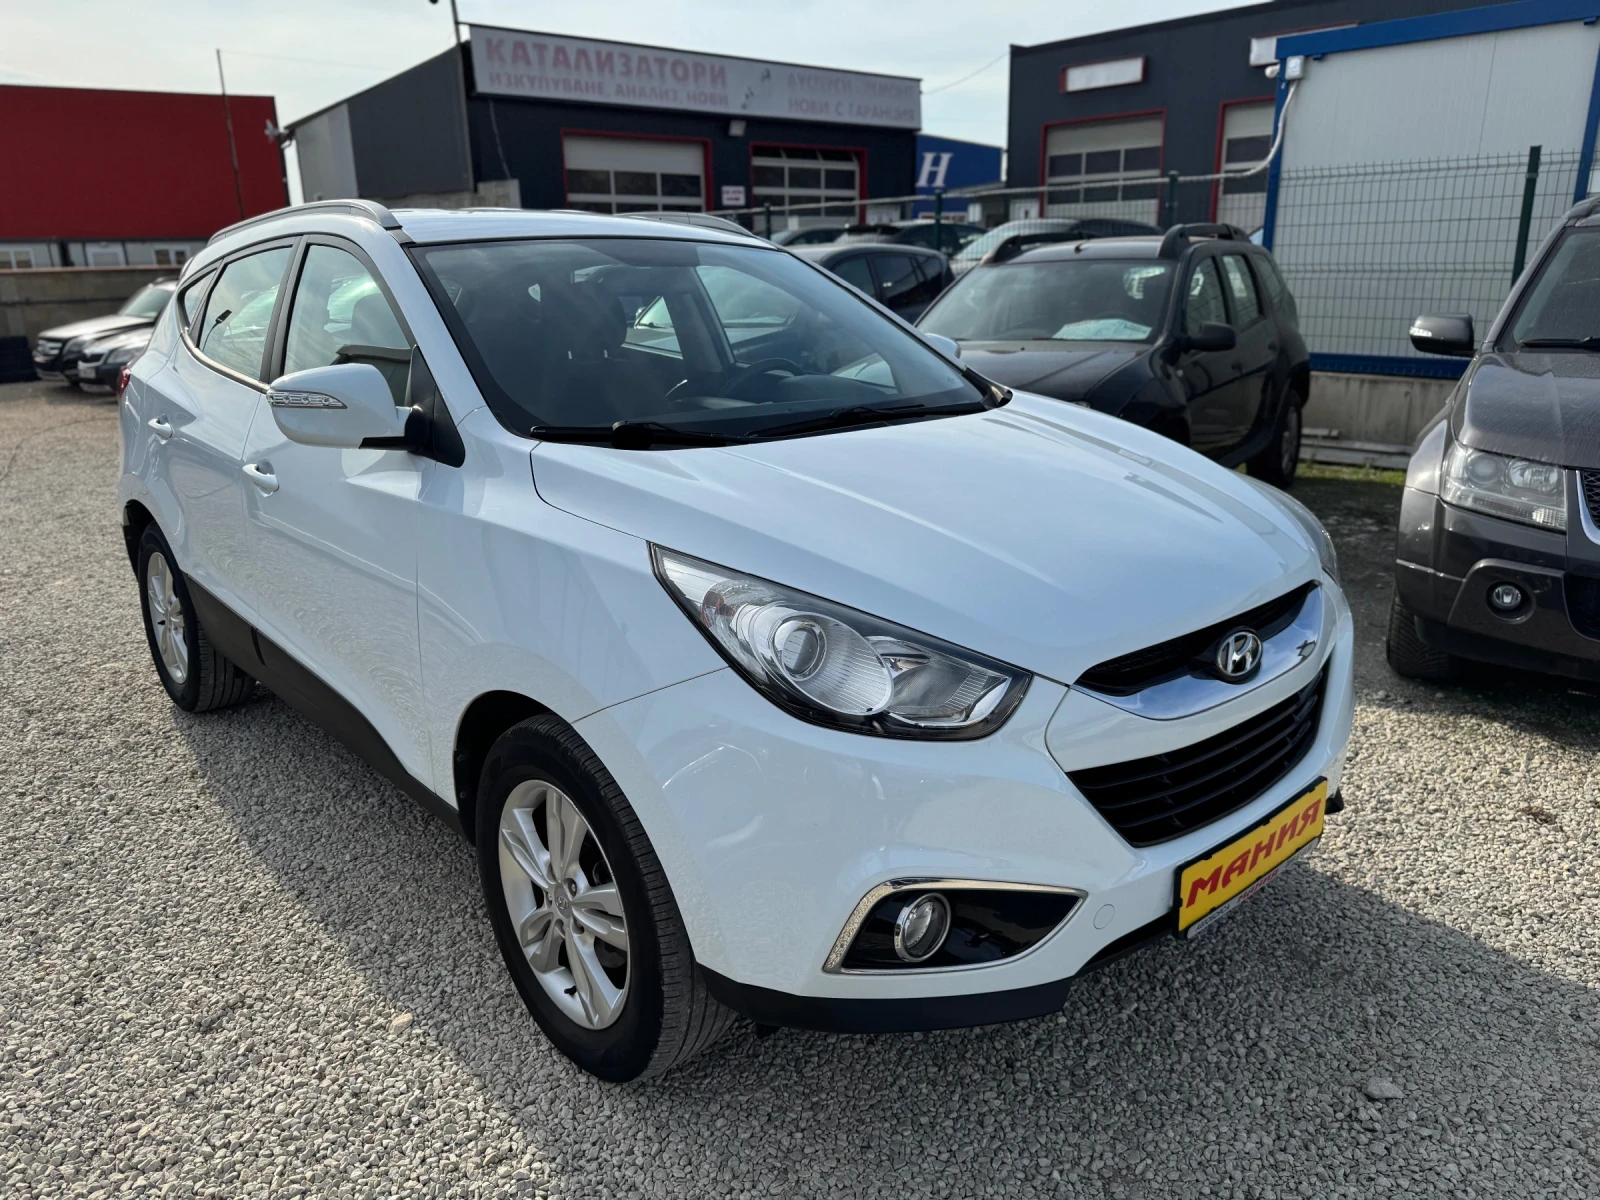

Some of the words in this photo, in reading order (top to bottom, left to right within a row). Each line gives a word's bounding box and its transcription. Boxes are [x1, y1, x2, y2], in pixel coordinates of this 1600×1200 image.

[485, 37, 728, 88] КАТАЛИЗАТОРИ
[915, 152, 954, 188] H
[1185, 798, 1322, 909] МАНИЯ
